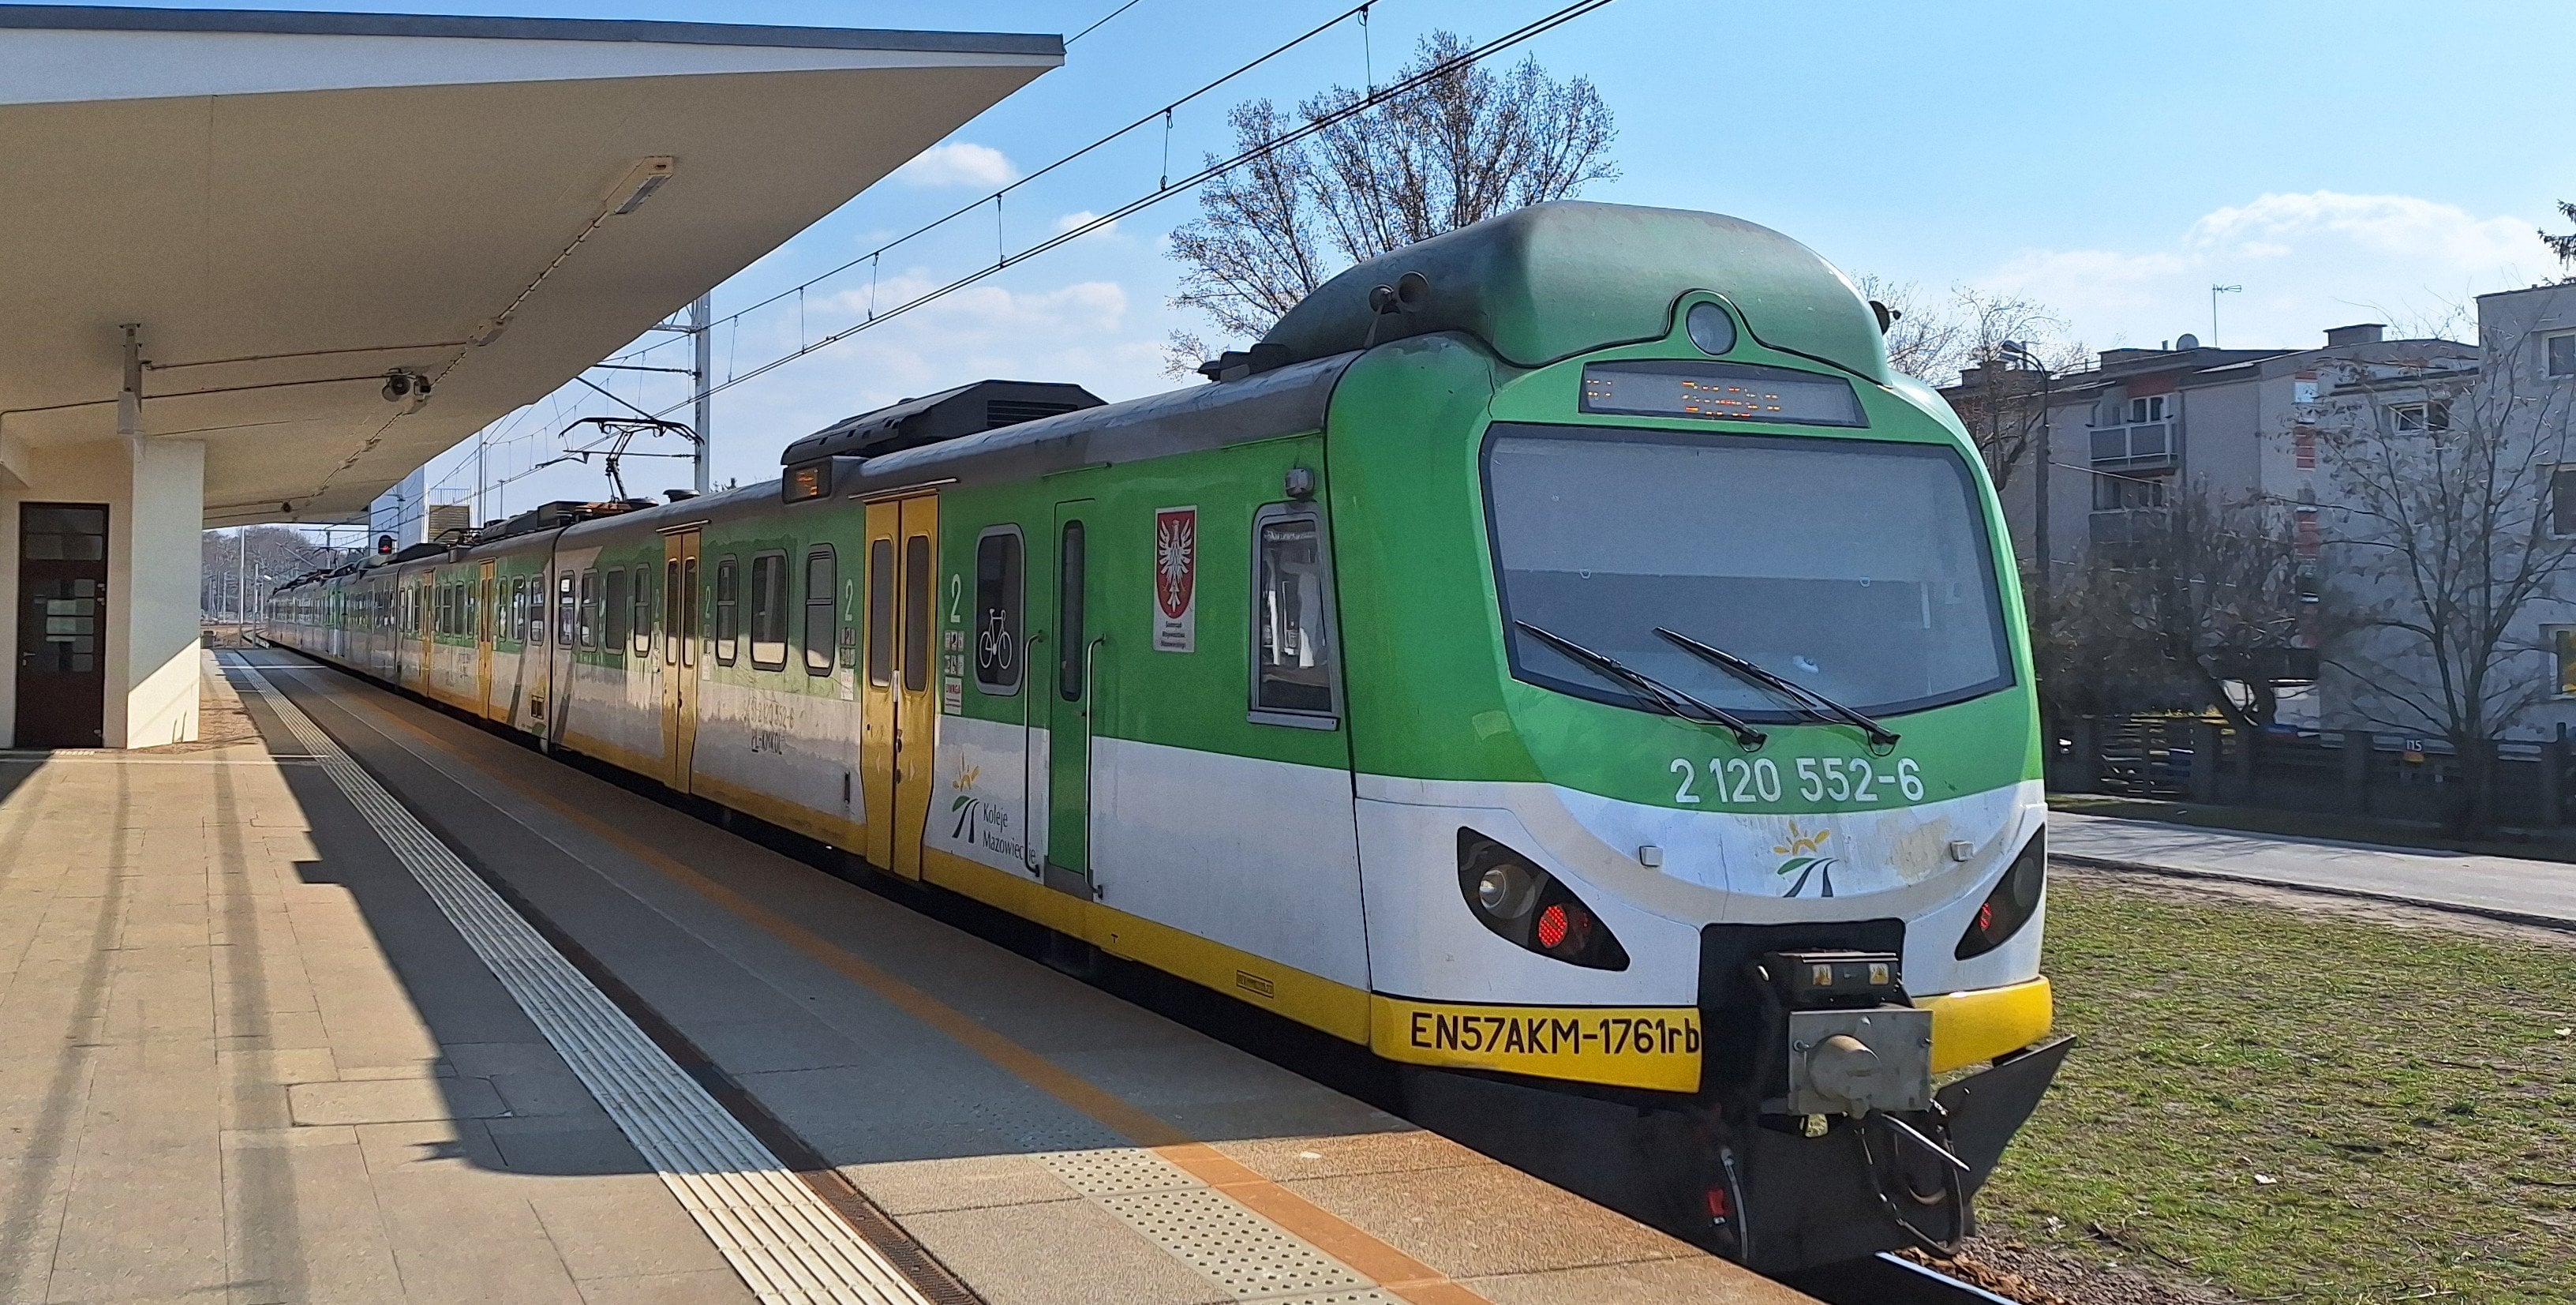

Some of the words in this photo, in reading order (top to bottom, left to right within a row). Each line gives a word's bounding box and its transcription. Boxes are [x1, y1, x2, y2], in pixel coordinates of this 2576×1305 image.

[845, 578, 854, 621] 2
[951, 573, 962, 623] 2
[1670, 758, 1701, 804] 2
[1709, 757, 1781, 803] 120
[1796, 756, 1925, 802] 552-6
[983, 803, 1009, 833] Koleje
[983, 830, 1036, 864] Mazowiecie
[1411, 1011, 1700, 1055] EN57AKM-1761rb
